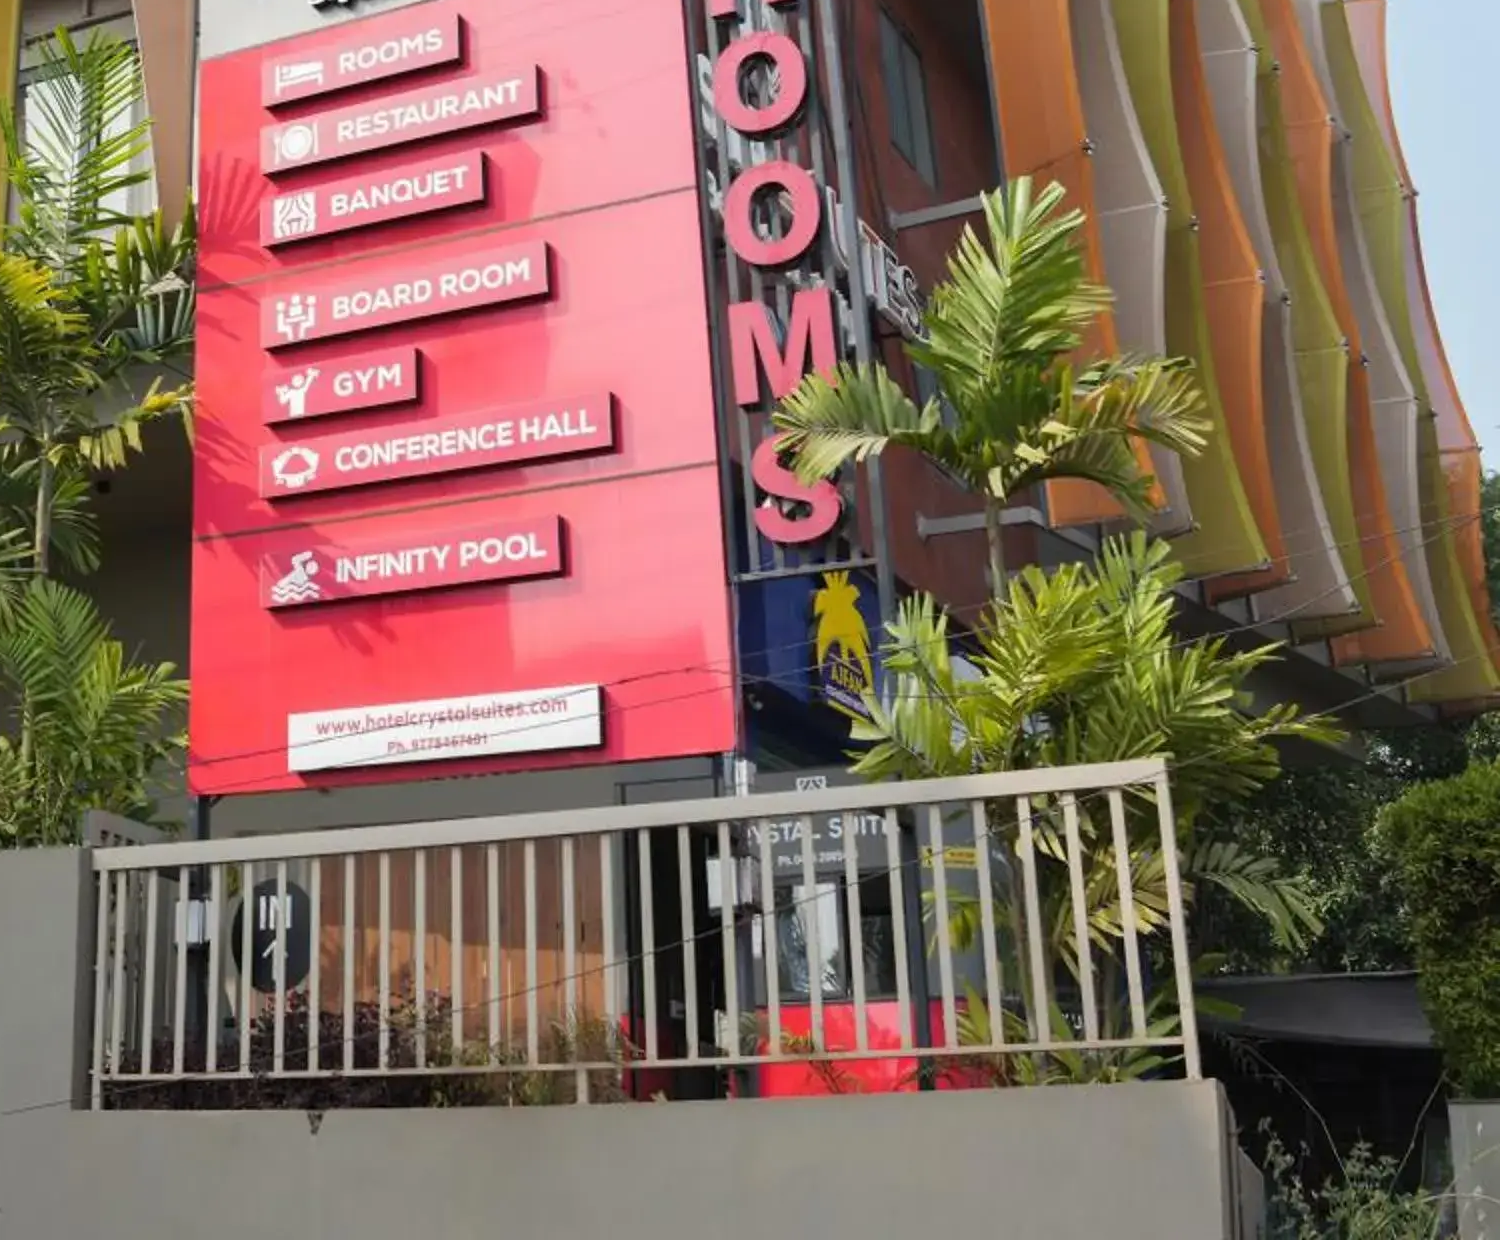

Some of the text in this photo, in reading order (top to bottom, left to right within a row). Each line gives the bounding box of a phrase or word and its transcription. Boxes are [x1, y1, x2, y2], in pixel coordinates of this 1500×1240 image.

[339, 29, 443, 74] ROOMS
[337, 79, 522, 142] RESTAURANT
[331, 165, 469, 217] BANQUET
[332, 257, 531, 320] BOARD ROOM
[333, 363, 402, 397] GYM
[335, 409, 597, 472] CONFERENCE HALL
[336, 532, 547, 583] INFINITY POOL
[316, 696, 568, 735] www.hotelcrystalsuites.com
[260, 895, 292, 930] IN
